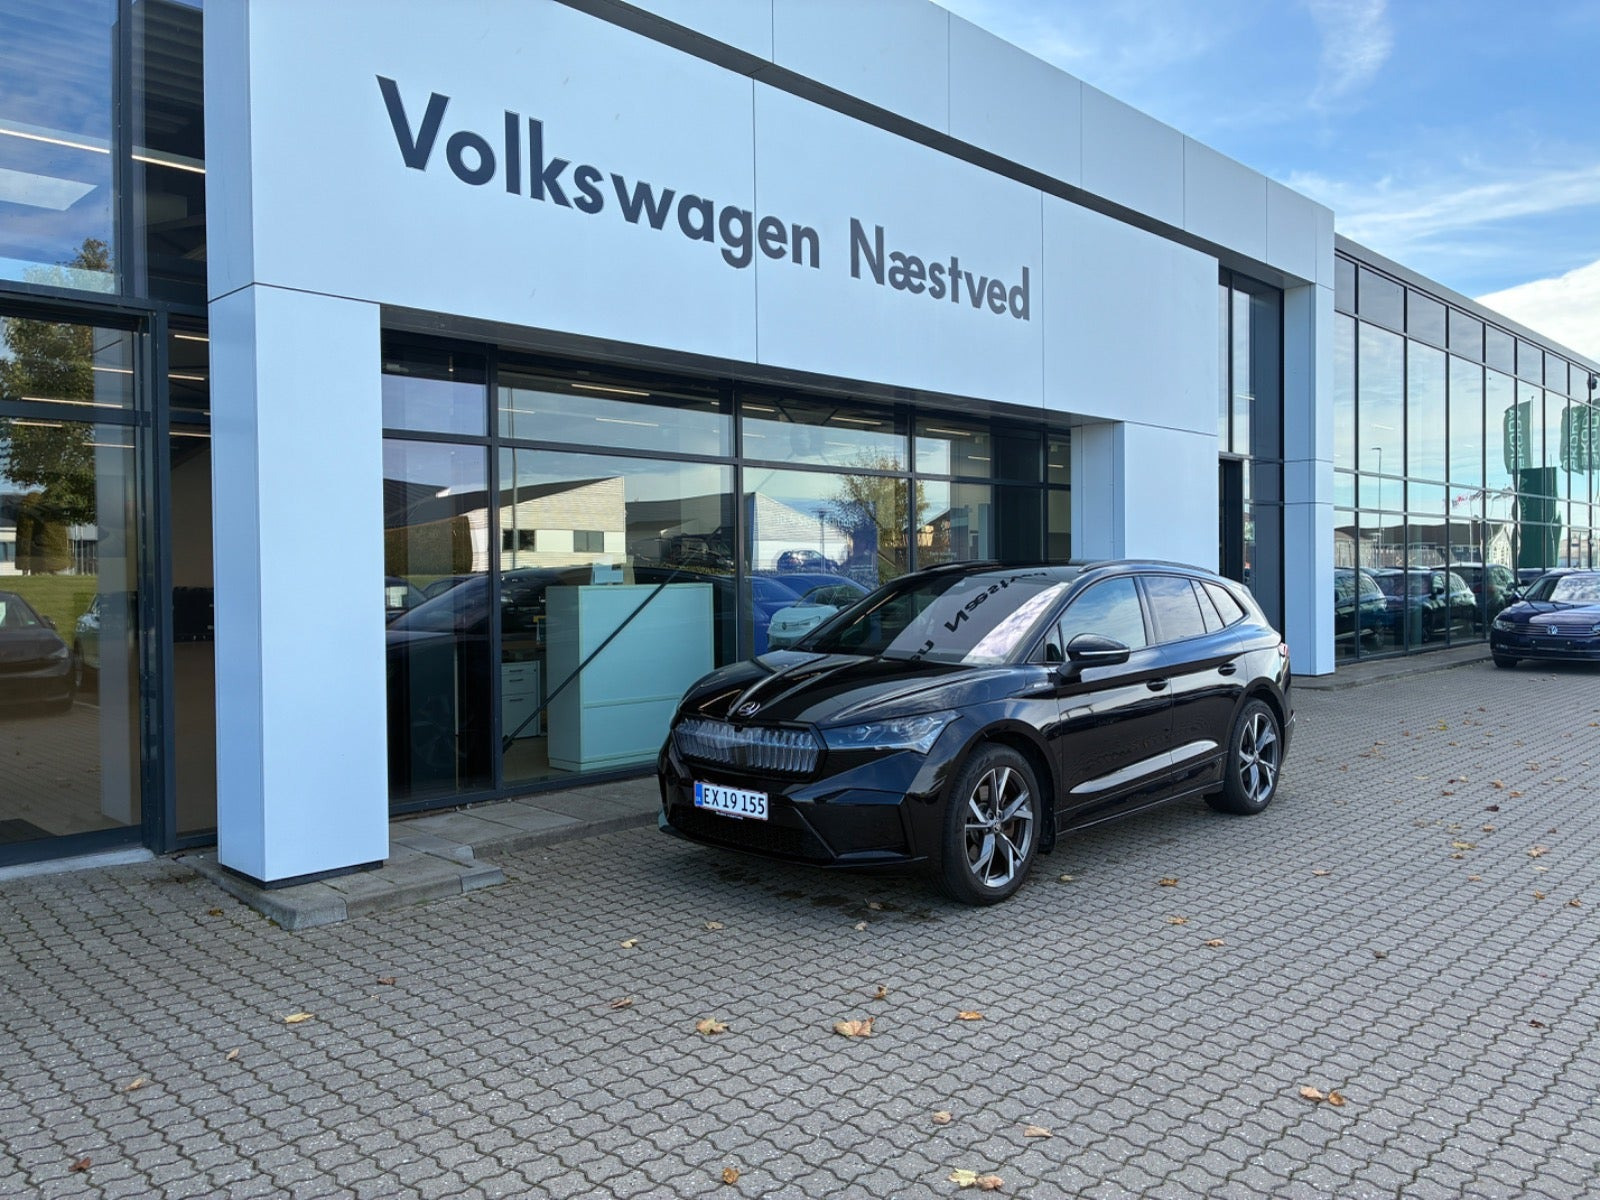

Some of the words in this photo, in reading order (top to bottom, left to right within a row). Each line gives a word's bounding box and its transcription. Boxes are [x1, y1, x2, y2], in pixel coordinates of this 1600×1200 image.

[375, 74, 820, 269] Volkswagen
[850, 217, 1030, 321] Næstved
[704, 787, 719, 806] EX
[723, 791, 737, 809] 19
[741, 794, 765, 815] 155
